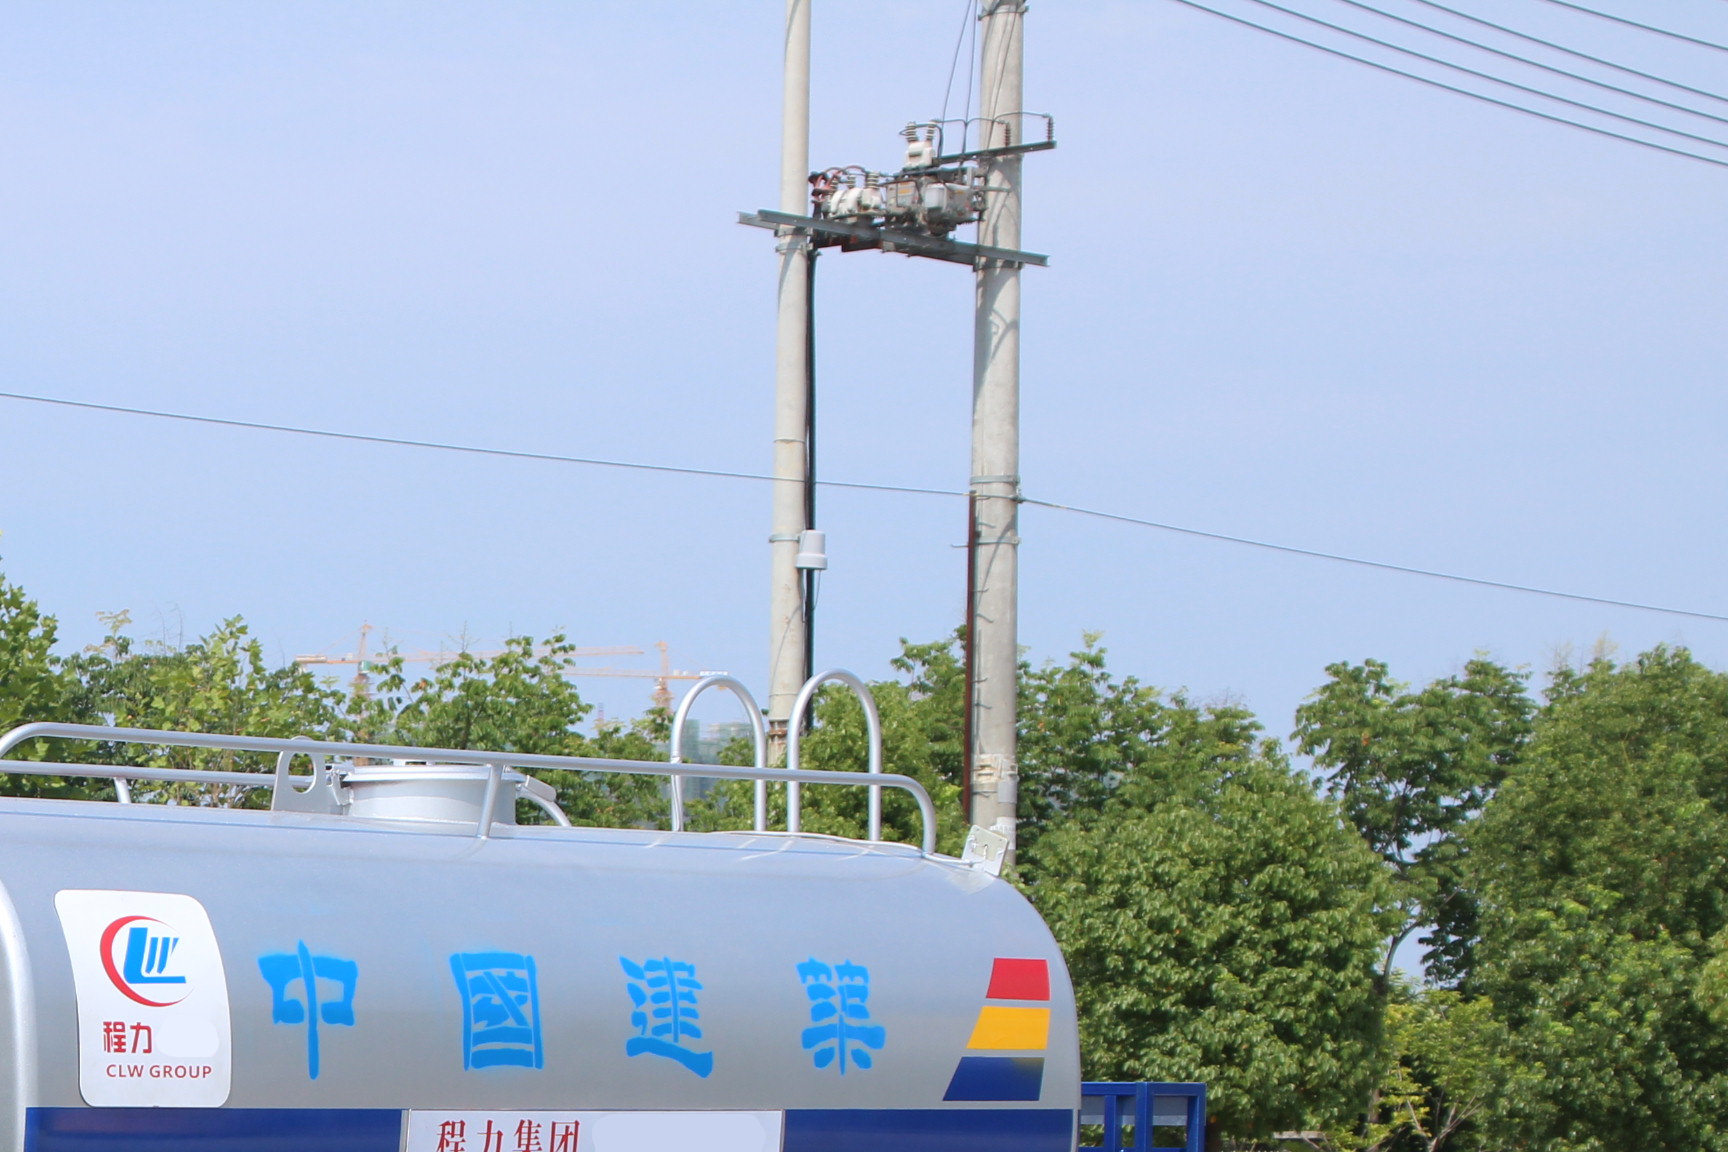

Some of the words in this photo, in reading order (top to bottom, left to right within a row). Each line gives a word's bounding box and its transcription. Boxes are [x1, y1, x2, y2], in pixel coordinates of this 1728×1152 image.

[103, 1021, 153, 1054] 程力
[106, 1064, 144, 1078] CLW
[149, 1064, 212, 1079] GROUP
